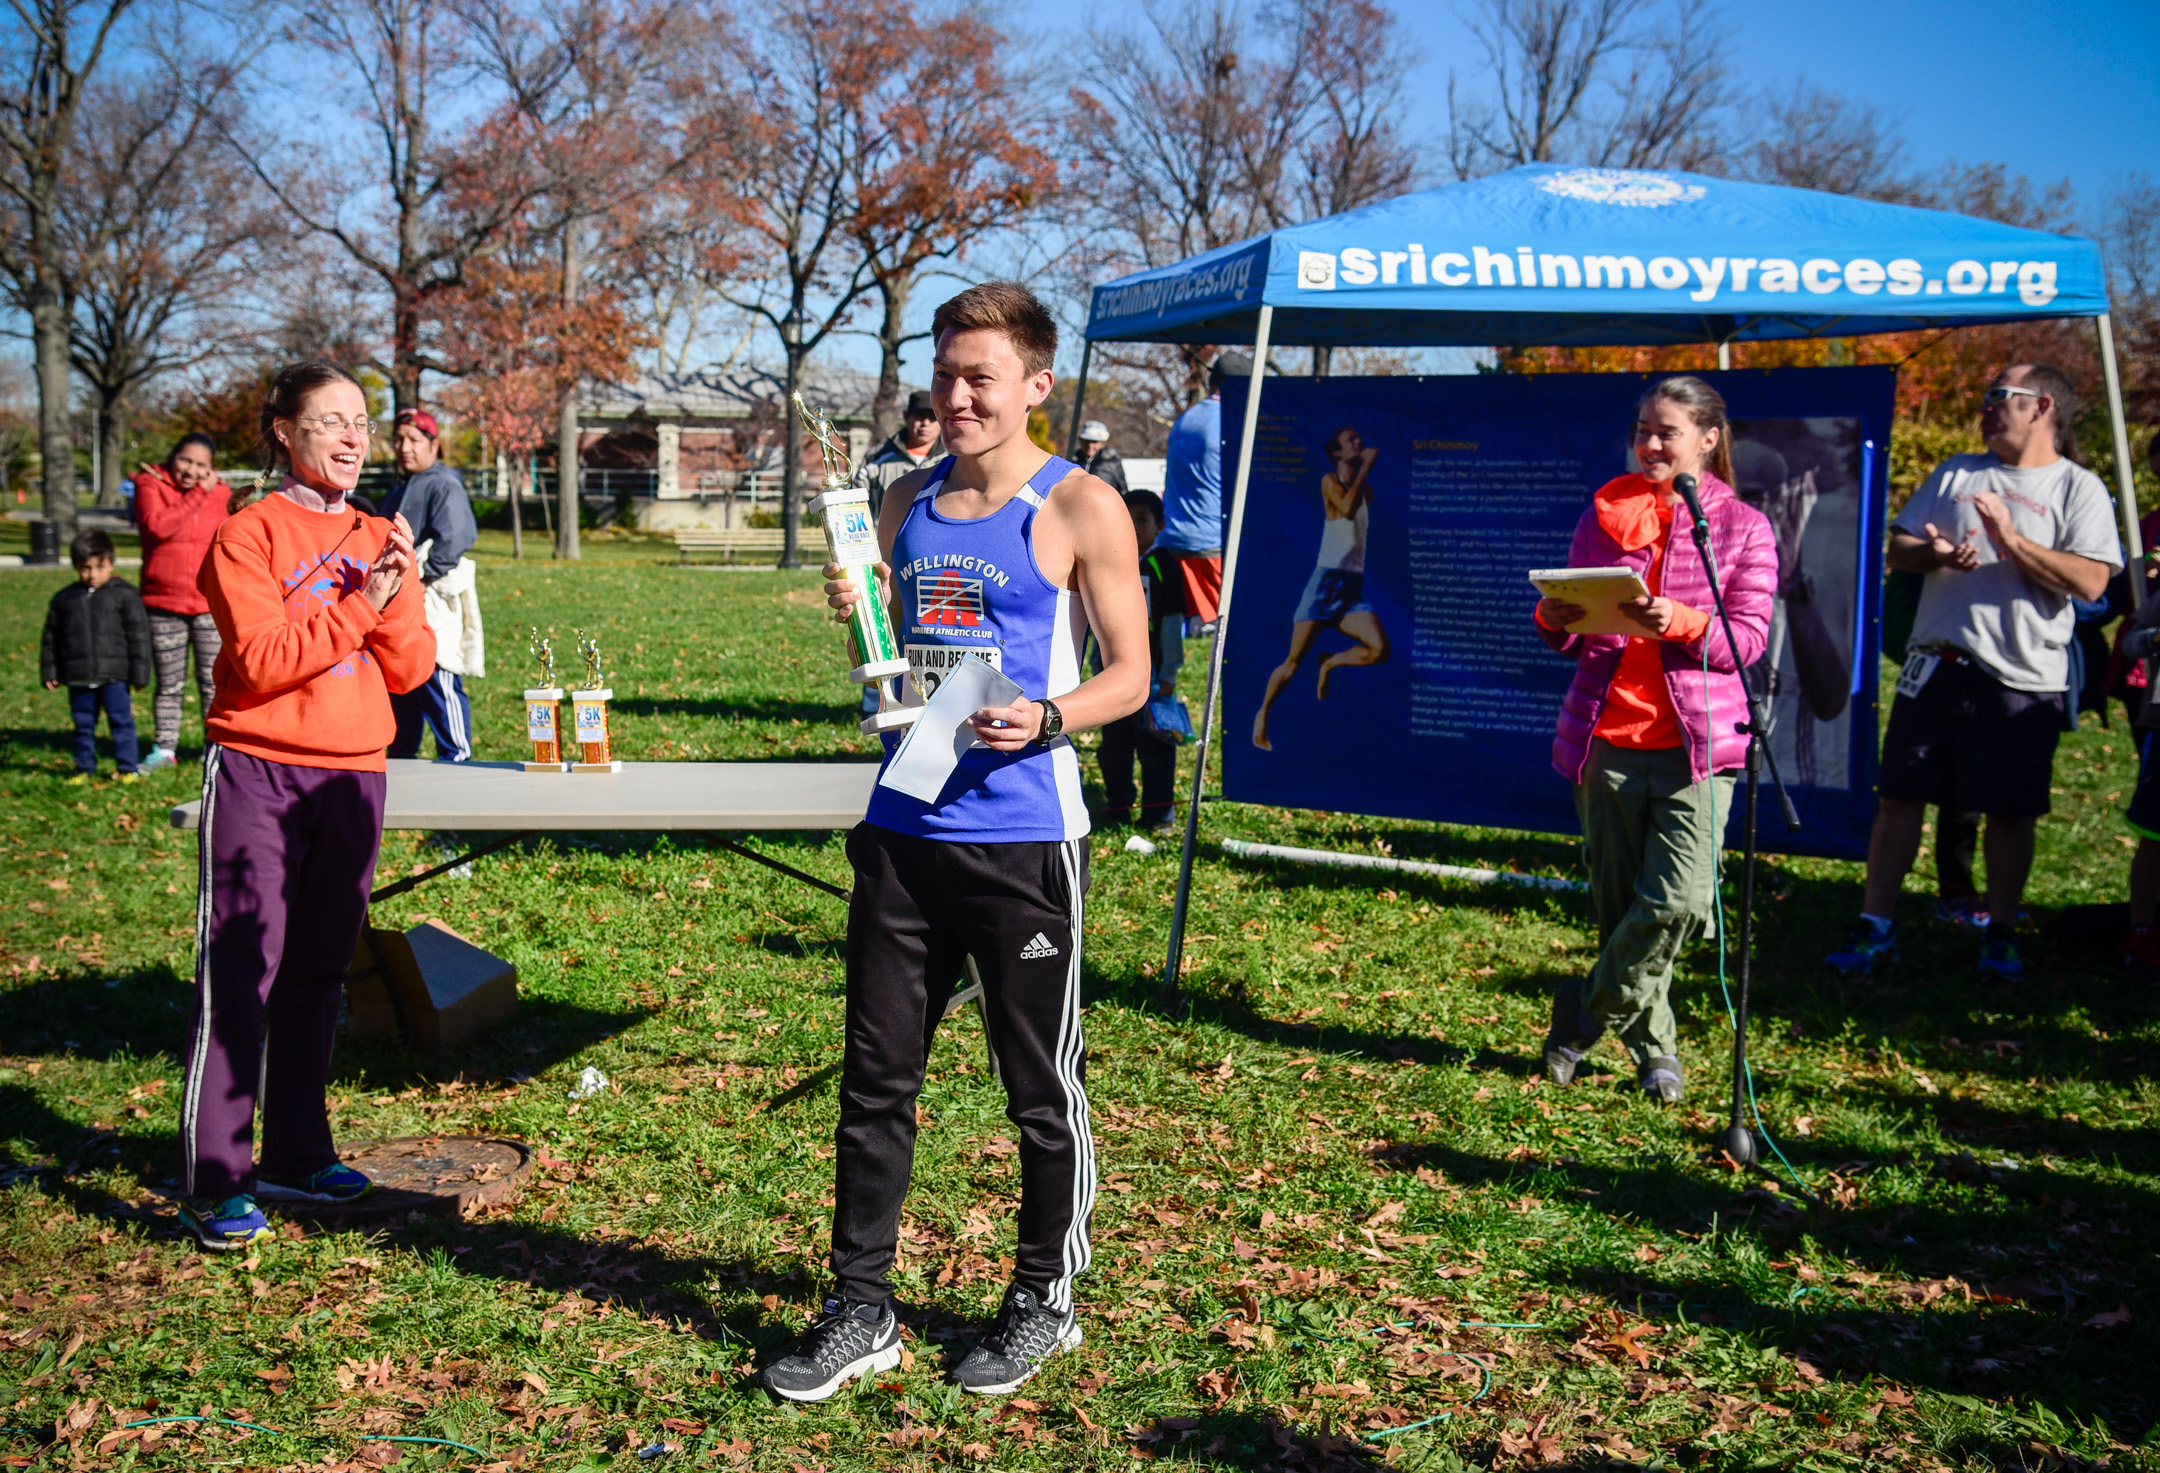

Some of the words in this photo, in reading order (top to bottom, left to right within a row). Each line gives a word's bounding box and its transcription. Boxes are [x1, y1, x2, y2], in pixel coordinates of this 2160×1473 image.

[1339, 243, 2058, 306] srichinmoyraces.org
[1096, 254, 1256, 318] srichinmoyraces.org
[1412, 438, 1427, 451] Sri
[1429, 439, 1479, 454] Chinmoy
[844, 512, 869, 533] 5K
[900, 554, 1010, 588] WELLINGTON
[935, 627, 970, 637] ATHLETIC
[971, 629, 993, 639] CLUB
[925, 648, 946, 669] AND
[948, 650, 992, 669] BEME
[536, 706, 551, 720] 5K
[585, 707, 601, 721] 5K
[1020, 947, 1059, 960] adidas
